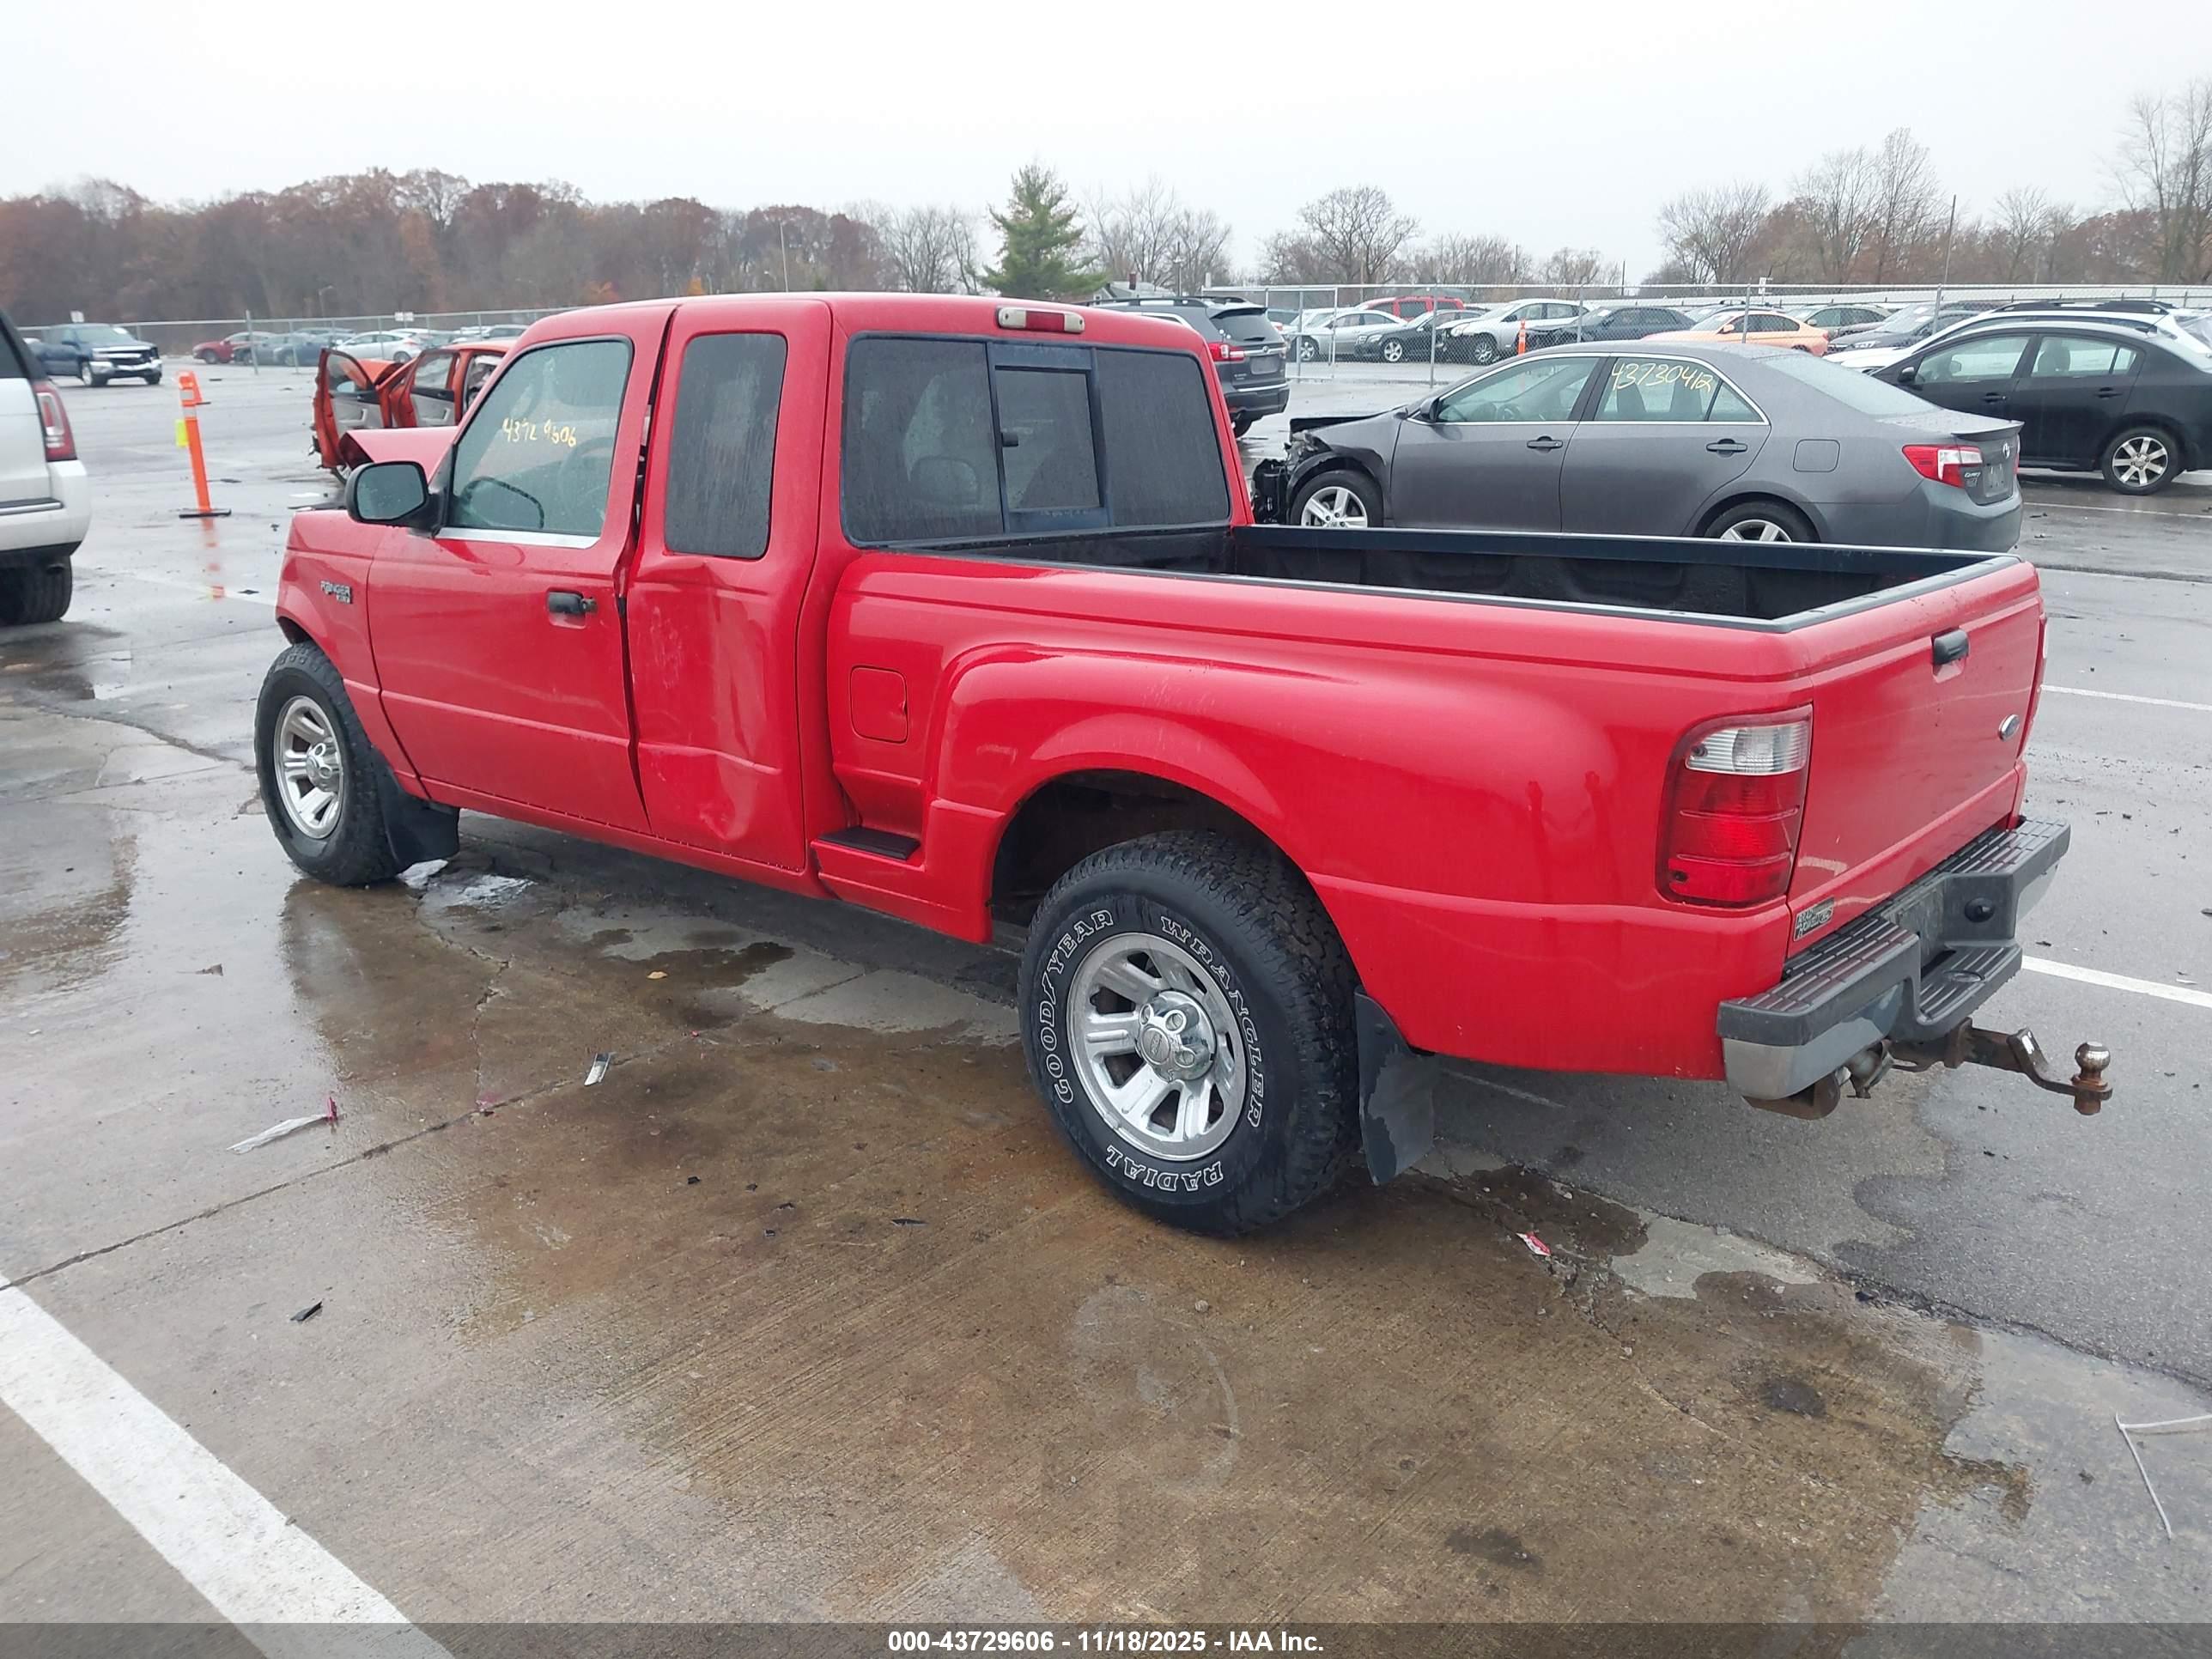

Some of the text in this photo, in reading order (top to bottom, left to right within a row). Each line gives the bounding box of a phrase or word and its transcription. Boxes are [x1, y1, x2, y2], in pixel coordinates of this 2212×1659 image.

[1611, 362, 1714, 392] 43730412
[1160, 915, 1265, 1127] WRANGLER
[1105, 1145, 1224, 1192] RADIAL
